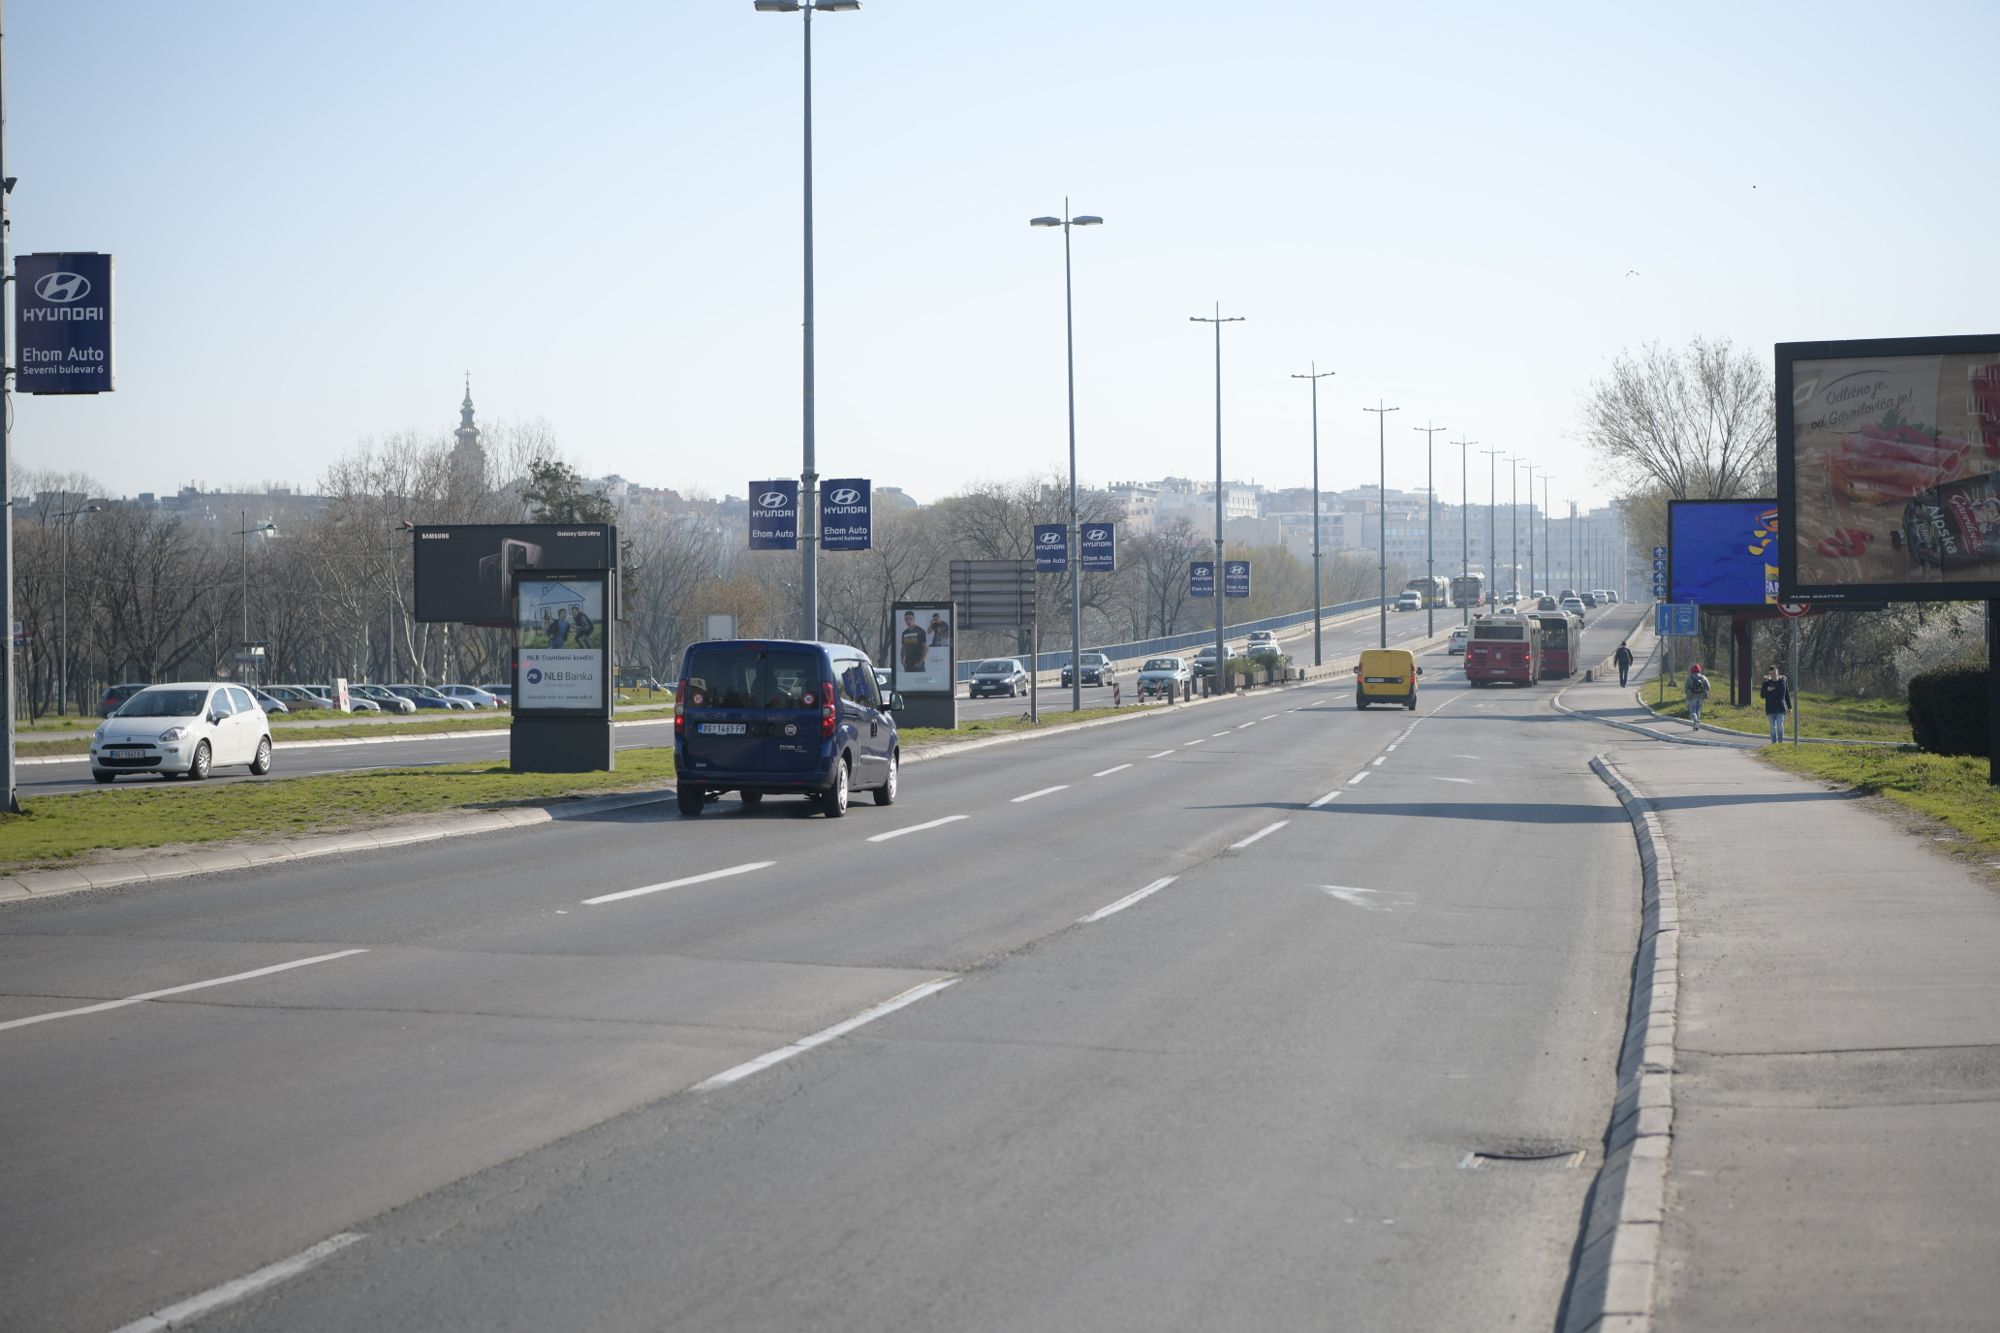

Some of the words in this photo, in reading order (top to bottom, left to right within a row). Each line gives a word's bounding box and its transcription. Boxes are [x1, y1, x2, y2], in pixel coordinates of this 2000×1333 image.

[23, 307, 104, 322] HYUNDAI
[23, 347, 62, 361] Ehom
[67, 346, 104, 361] Auto
[23, 365, 57, 375] Severni
[60, 364, 95, 374] bulevar
[97, 364, 104, 373] 6
[1811, 413, 1826, 430] od
[752, 509, 795, 517] HYUNDAI
[824, 506, 867, 514] HYUNDAI
[752, 530, 773, 538] Ehom
[775, 530, 794, 538] Auto
[824, 526, 846, 535] Ehom
[848, 526, 867, 534] Auto
[1927, 505, 1958, 554] Alpska
[544, 672, 564, 680] NLB
[565, 672, 593, 680] Banka
